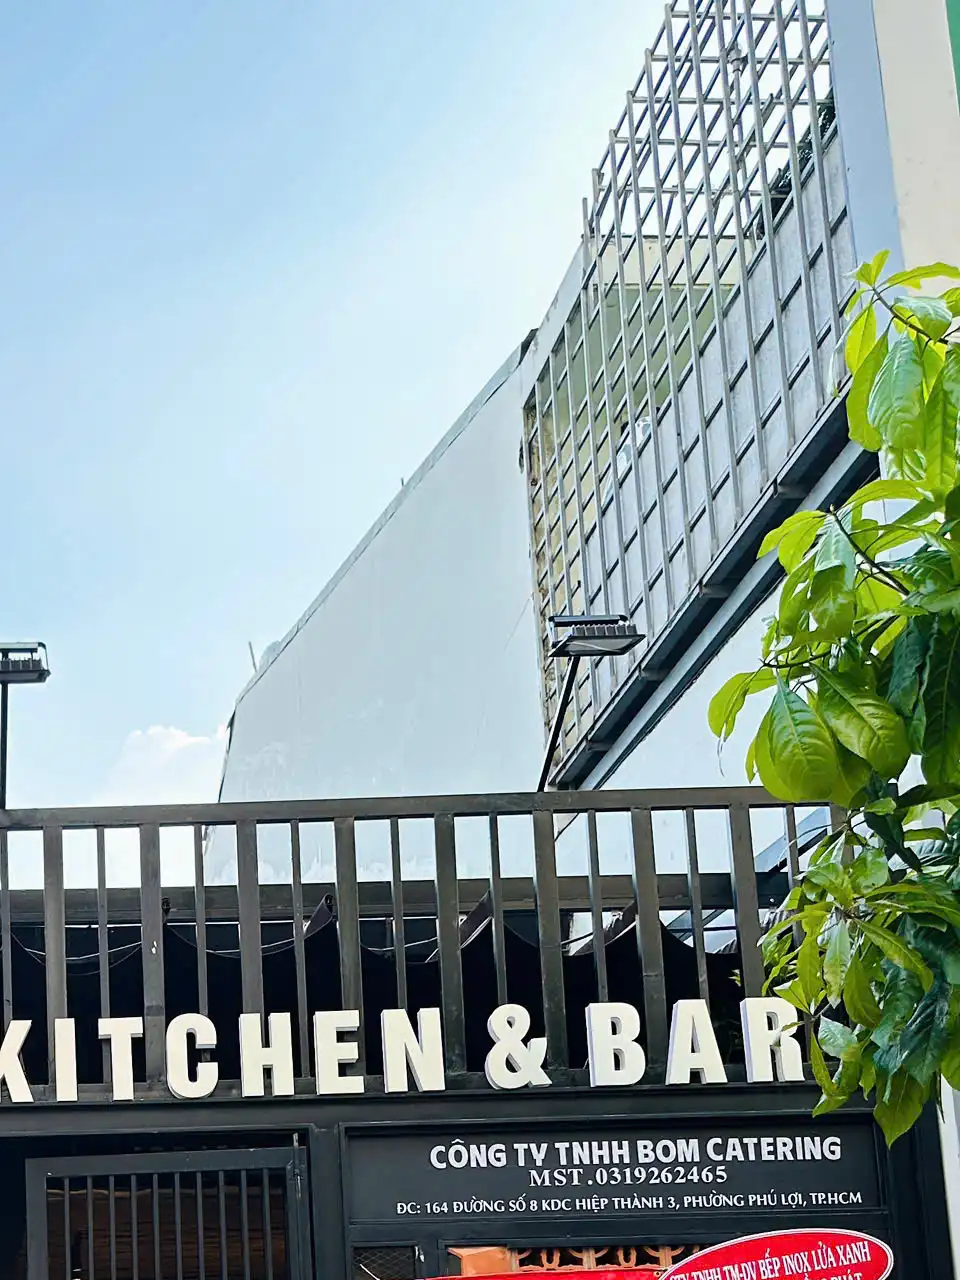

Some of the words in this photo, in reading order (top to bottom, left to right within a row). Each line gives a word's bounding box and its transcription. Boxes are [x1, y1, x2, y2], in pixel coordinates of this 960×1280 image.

[486, 1003, 552, 1089] &
[586, 997, 805, 1087] BAR
[429, 1138, 507, 1169] CÔNG
[513, 1143, 548, 1167] TY
[554, 1140, 630, 1166] TNHH
[637, 1138, 700, 1164] BOM
[706, 1136, 842, 1162] CATERING
[396, 1202, 421, 1214] ĐC:
[425, 1202, 448, 1214] 164
[453, 1195, 505, 1213] ĐƯỜNG
[509, 1193, 526, 1212] SỐ
[530, 1199, 538, 1211] 8
[542, 1198, 571, 1211] KDC
[576, 1195, 608, 1213] HIỆP
[612, 1193, 663, 1210] THÀNH
[667, 1197, 680, 1210] 3,
[684, 1190, 745, 1208] PHƯỜNG
[748, 1189, 777, 1206] PHÚ
[781, 1191, 807, 1208] LỢI,
[809, 1191, 862, 1205] TP.HCM
[759, 1248, 781, 1280] BẾP
[784, 1251, 811, 1276] INOX
[813, 1241, 836, 1270] LỬA
[836, 1241, 871, 1265] XANH
